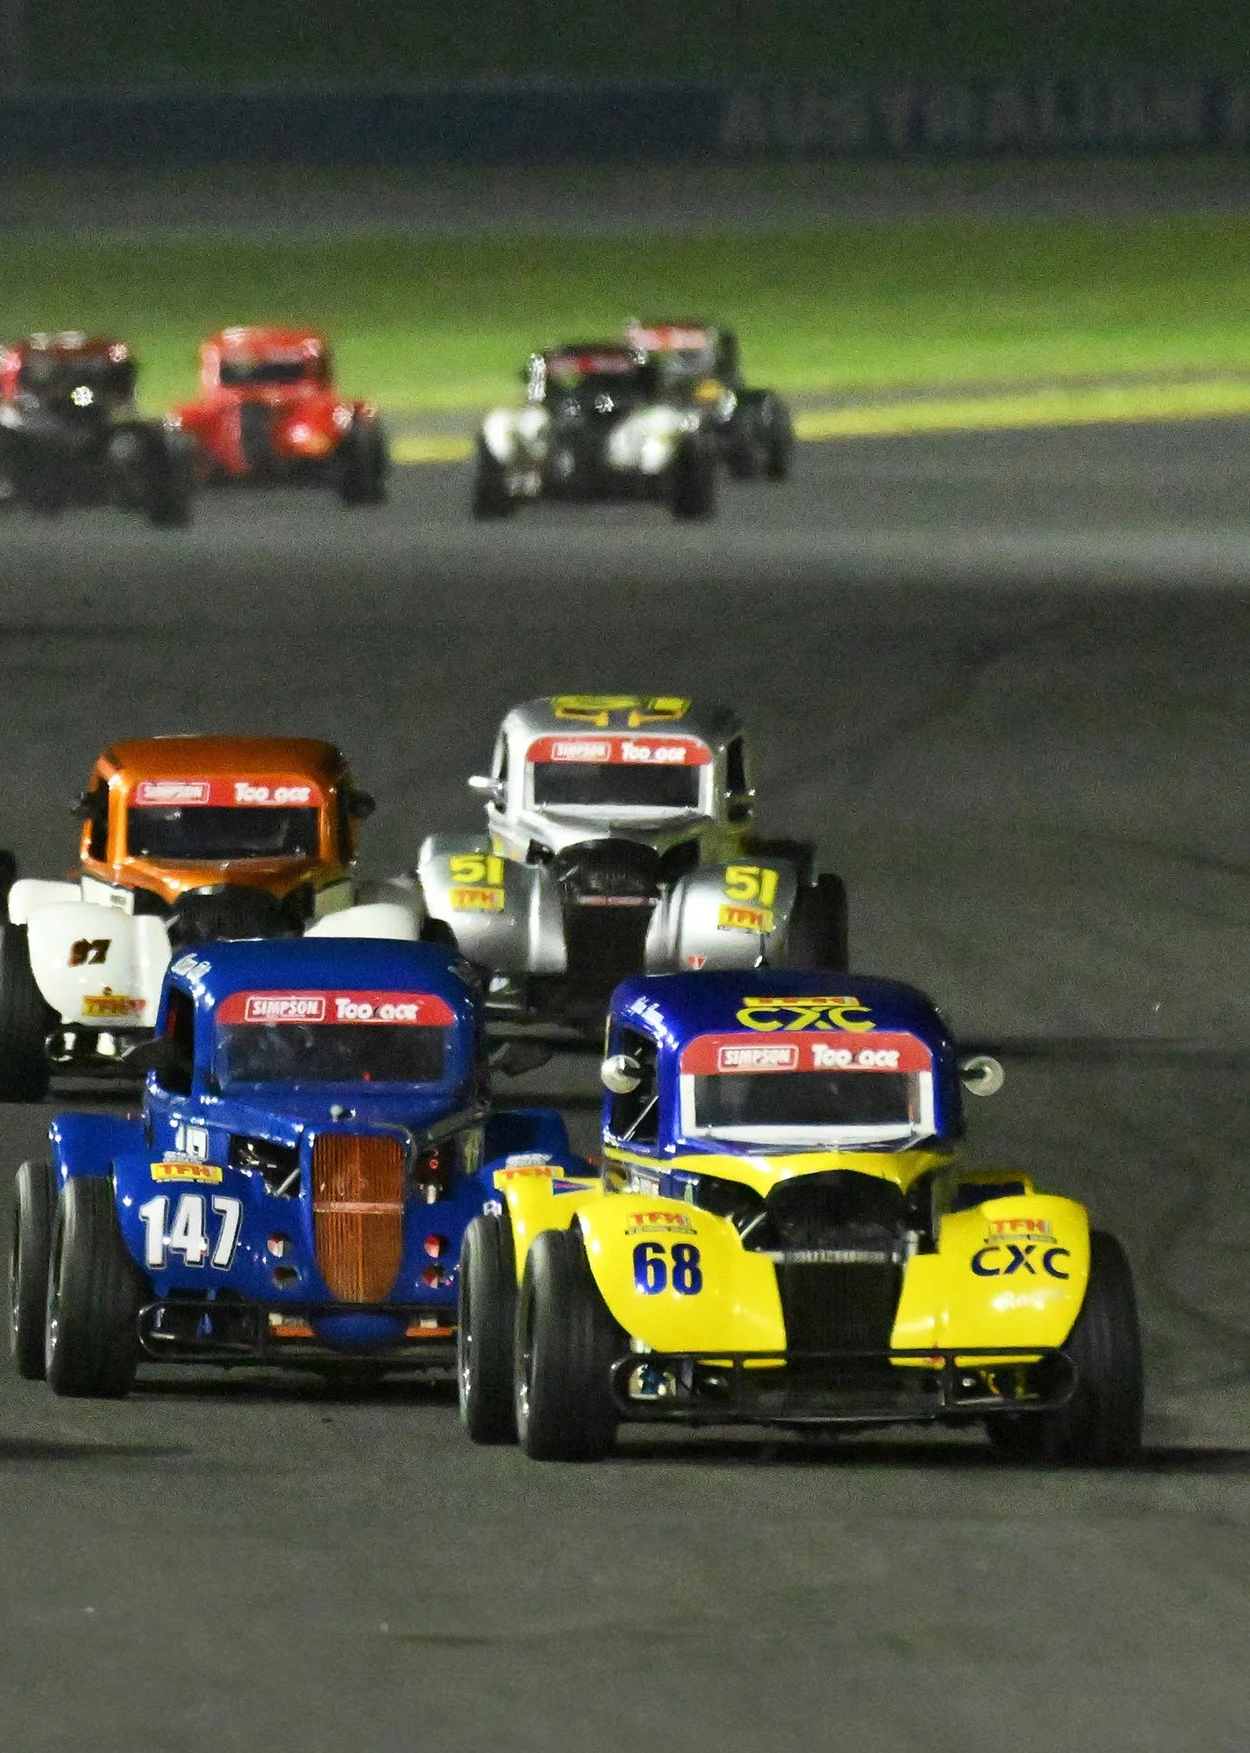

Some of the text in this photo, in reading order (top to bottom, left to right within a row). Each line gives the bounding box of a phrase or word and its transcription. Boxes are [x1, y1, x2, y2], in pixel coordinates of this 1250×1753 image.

[449, 854, 505, 886] 51
[725, 865, 780, 907] 51
[252, 999, 320, 1017] SIMPSON
[735, 1006, 877, 1032] CXC
[724, 1048, 791, 1067] SIMPSON
[139, 1193, 244, 1272] 147
[632, 1241, 703, 1296] 68
[970, 1243, 1071, 1280] CXC
